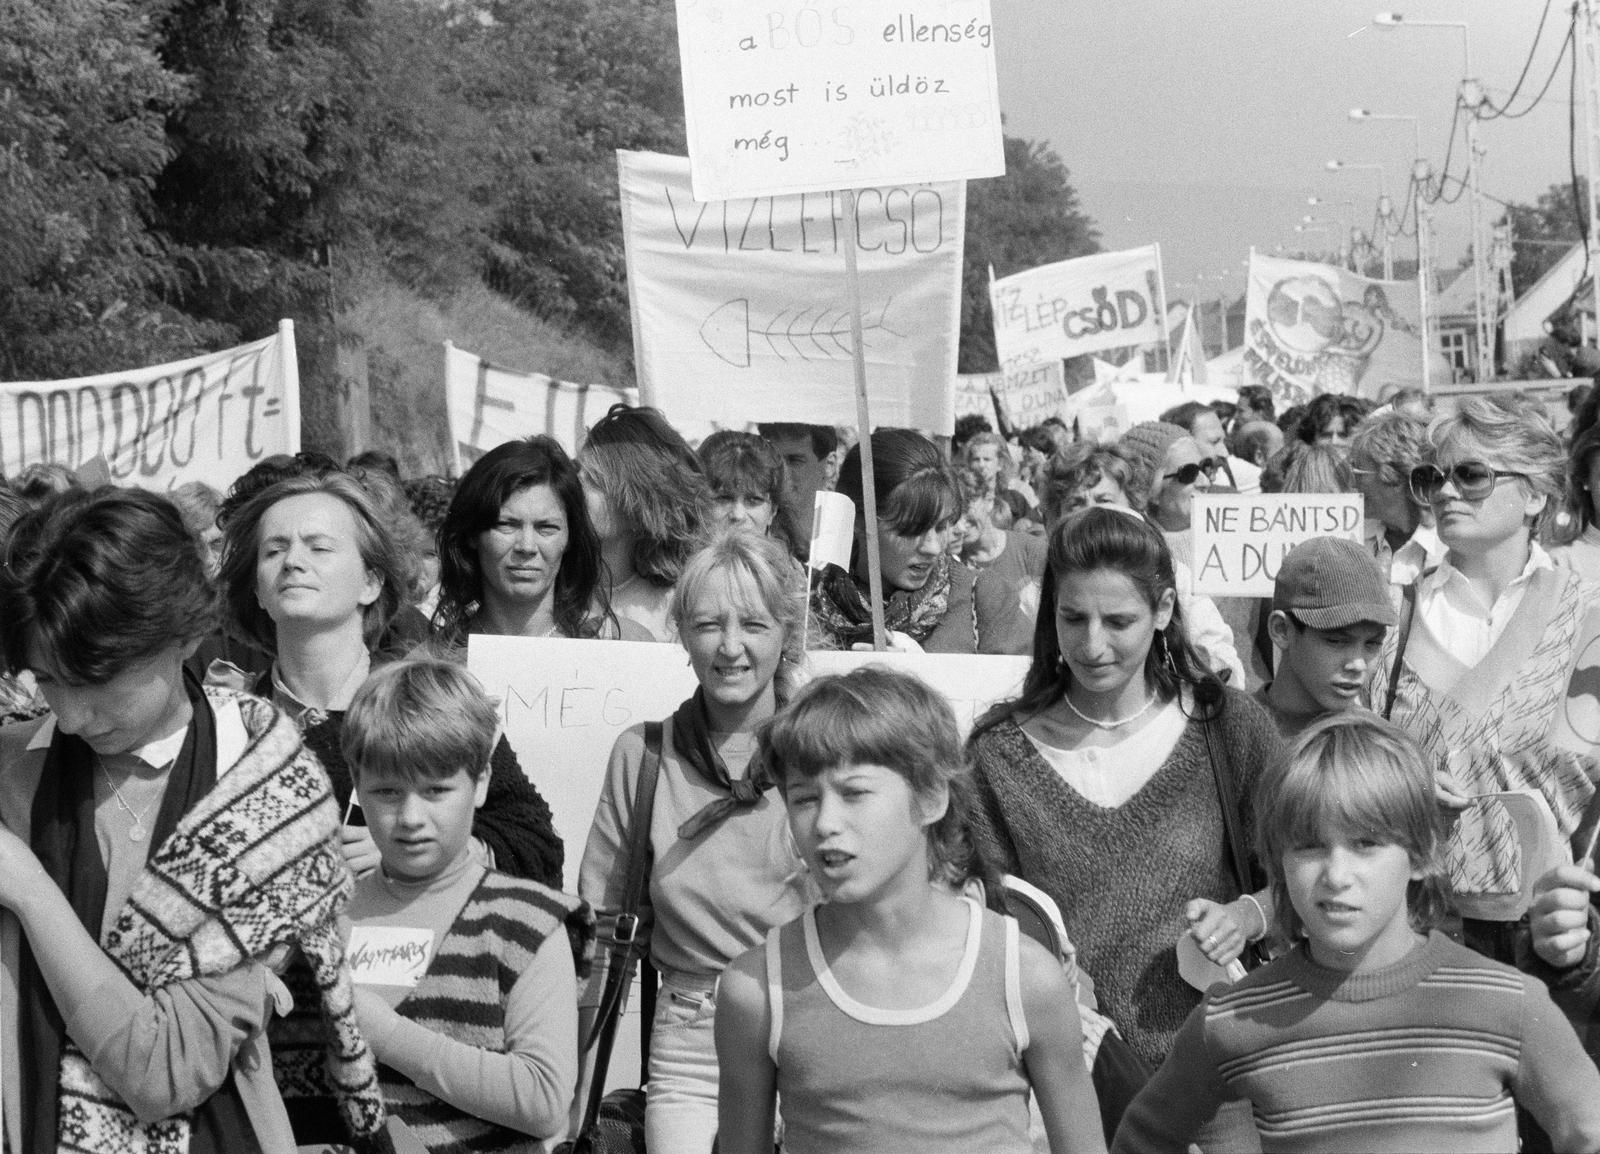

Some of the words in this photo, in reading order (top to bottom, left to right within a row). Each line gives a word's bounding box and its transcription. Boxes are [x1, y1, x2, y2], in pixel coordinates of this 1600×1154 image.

[738, 34, 758, 51] a
[882, 13, 991, 48] ellenség
[729, 82, 800, 110] most
[825, 81, 849, 103] is
[868, 74, 951, 97] üldöz
[733, 129, 790, 162] még
[1205, 506, 1240, 534] NE
[1249, 502, 1360, 533] BÁNTSD
[1198, 543, 1229, 582] A
[1241, 542, 1296, 582] DU
[503, 667, 633, 729] MÉG
